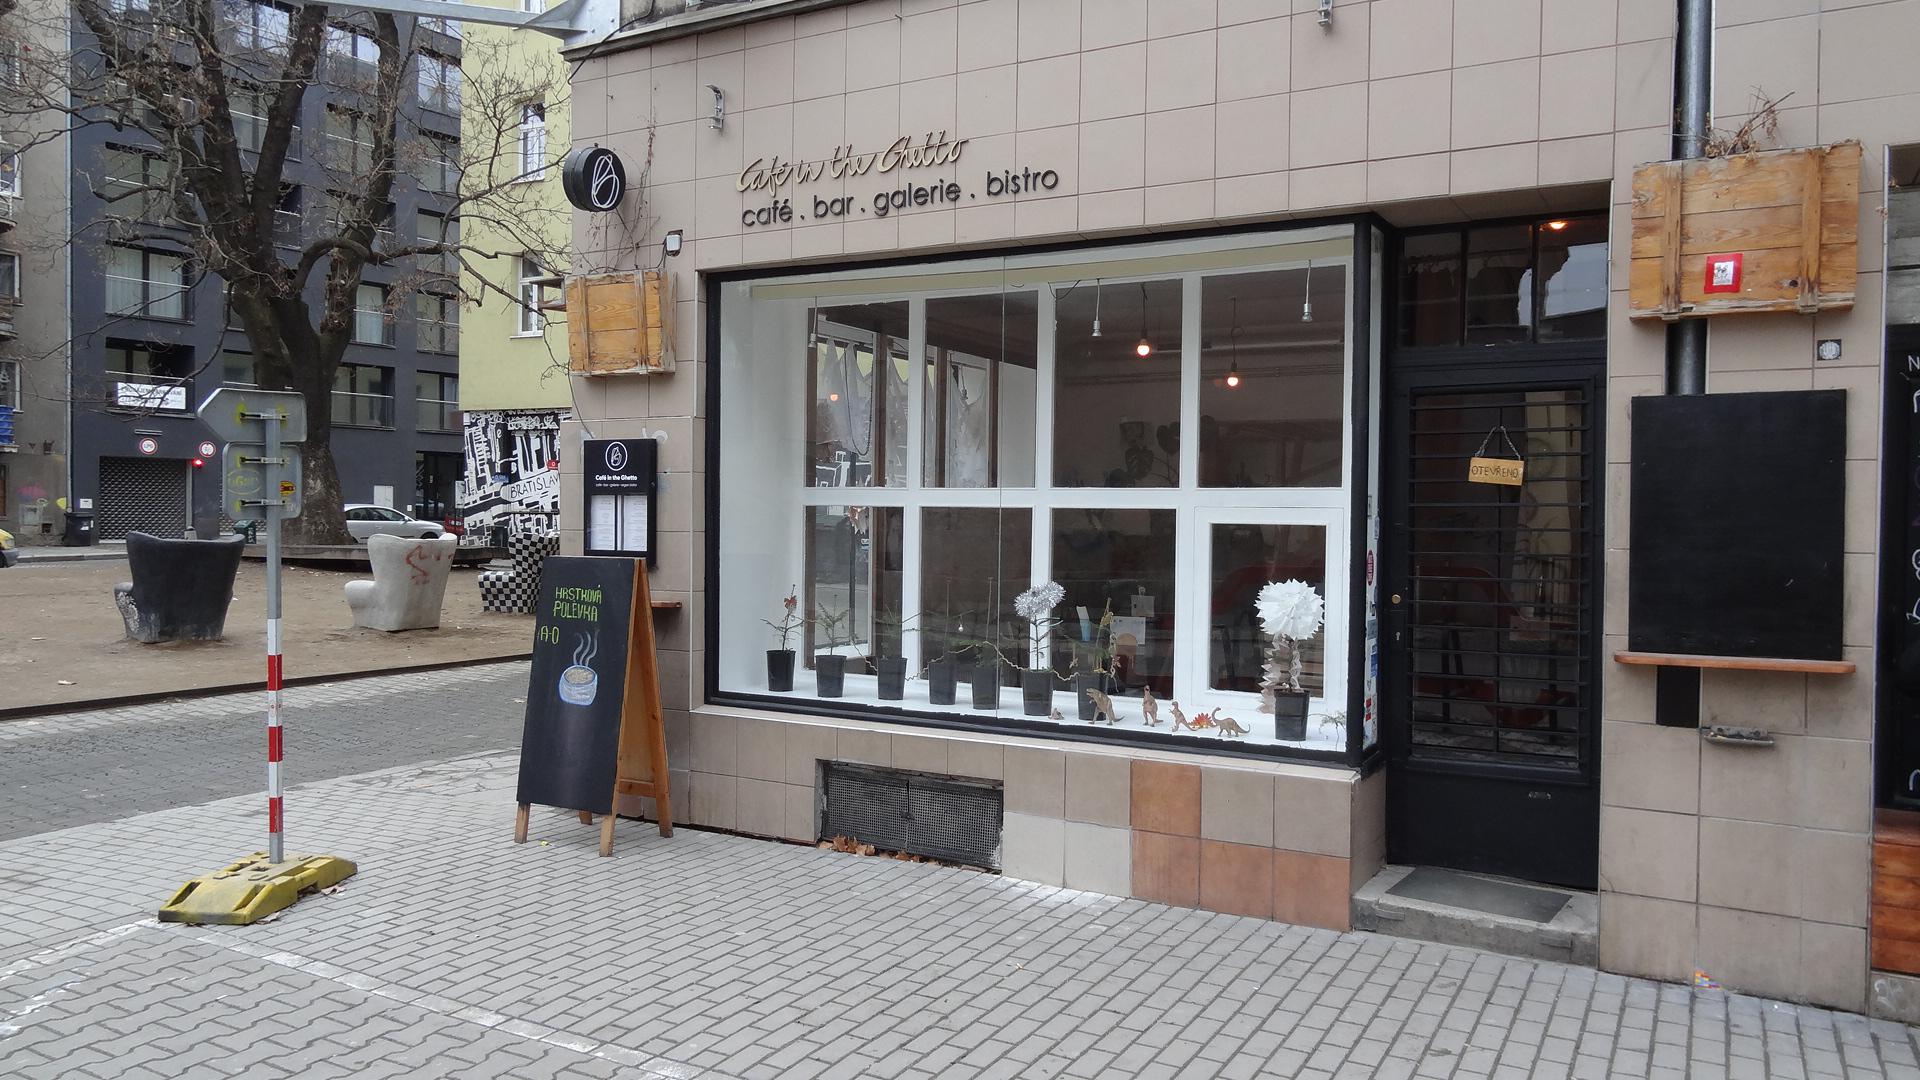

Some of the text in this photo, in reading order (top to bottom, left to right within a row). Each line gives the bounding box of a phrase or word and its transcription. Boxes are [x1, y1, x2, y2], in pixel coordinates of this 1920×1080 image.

[736, 130, 969, 198] Café in the Ghetto
[742, 166, 1059, 227] café bar galerie bistro
[1471, 465, 1519, 479] OTEVŘENO
